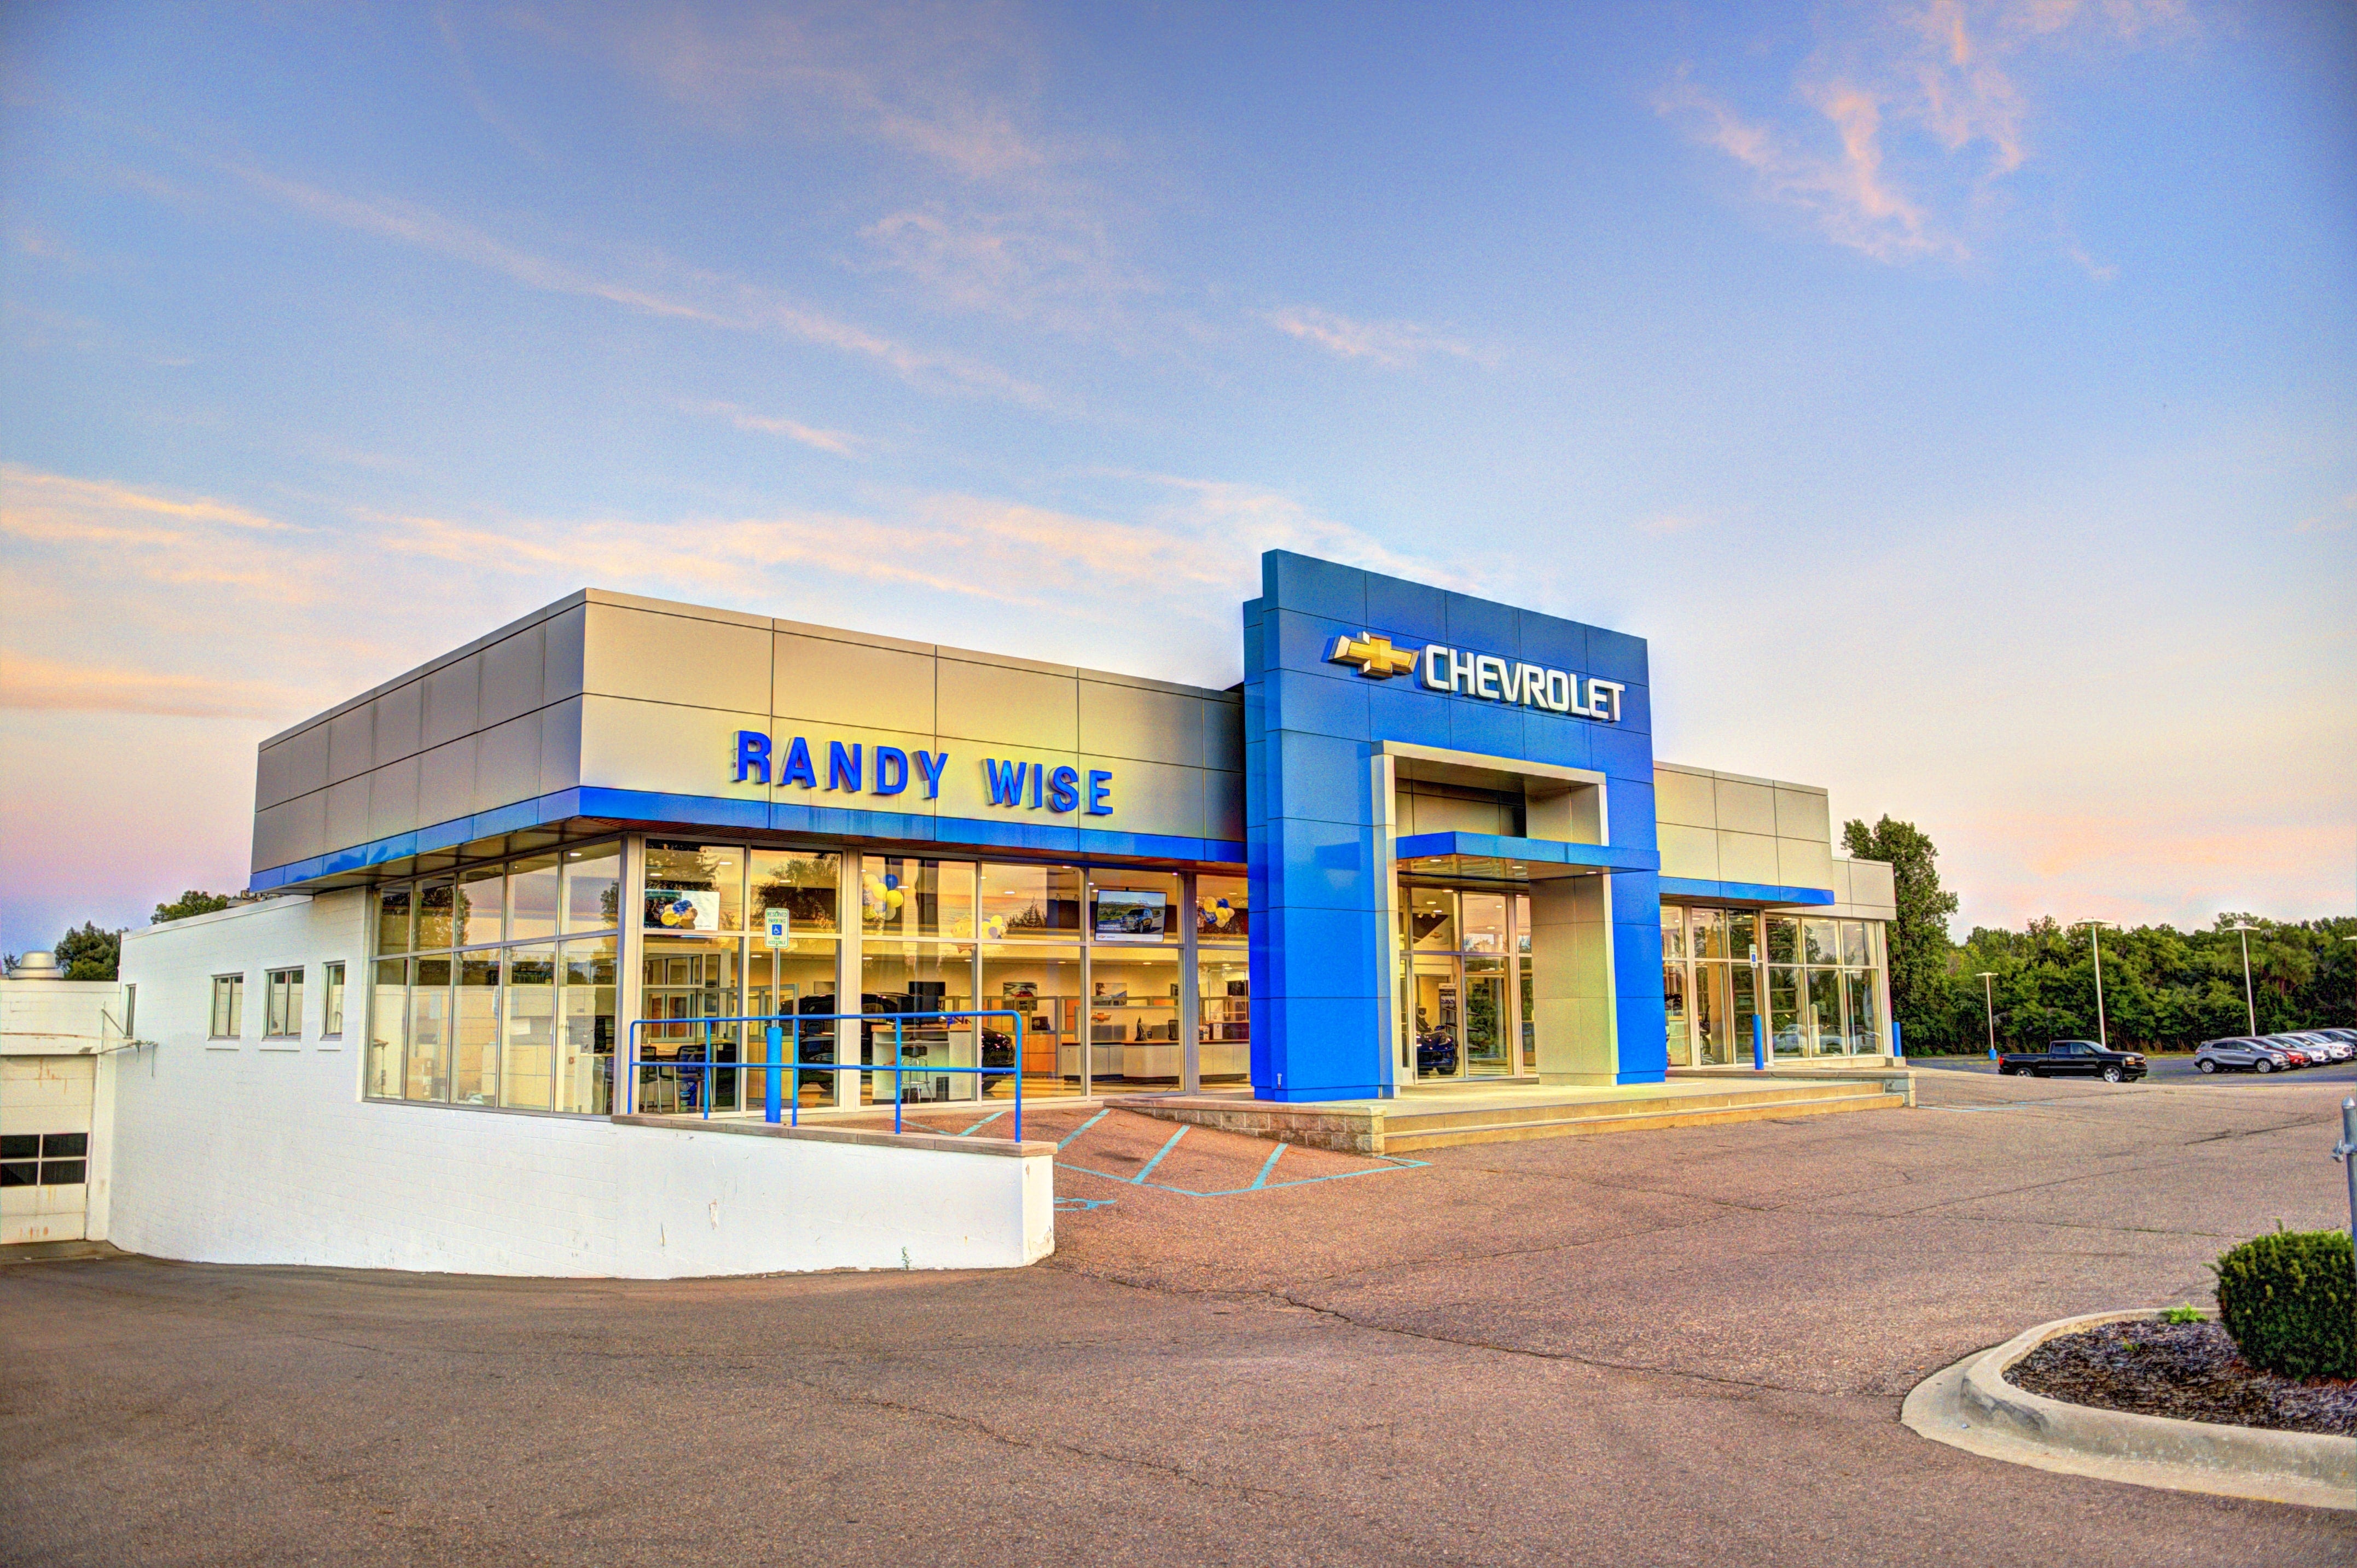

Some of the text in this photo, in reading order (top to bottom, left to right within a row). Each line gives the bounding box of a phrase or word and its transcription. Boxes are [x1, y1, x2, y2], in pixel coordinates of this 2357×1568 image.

[1421, 644, 1625, 722] CHEVROLET
[734, 730, 1113, 815] RANDY WISE
